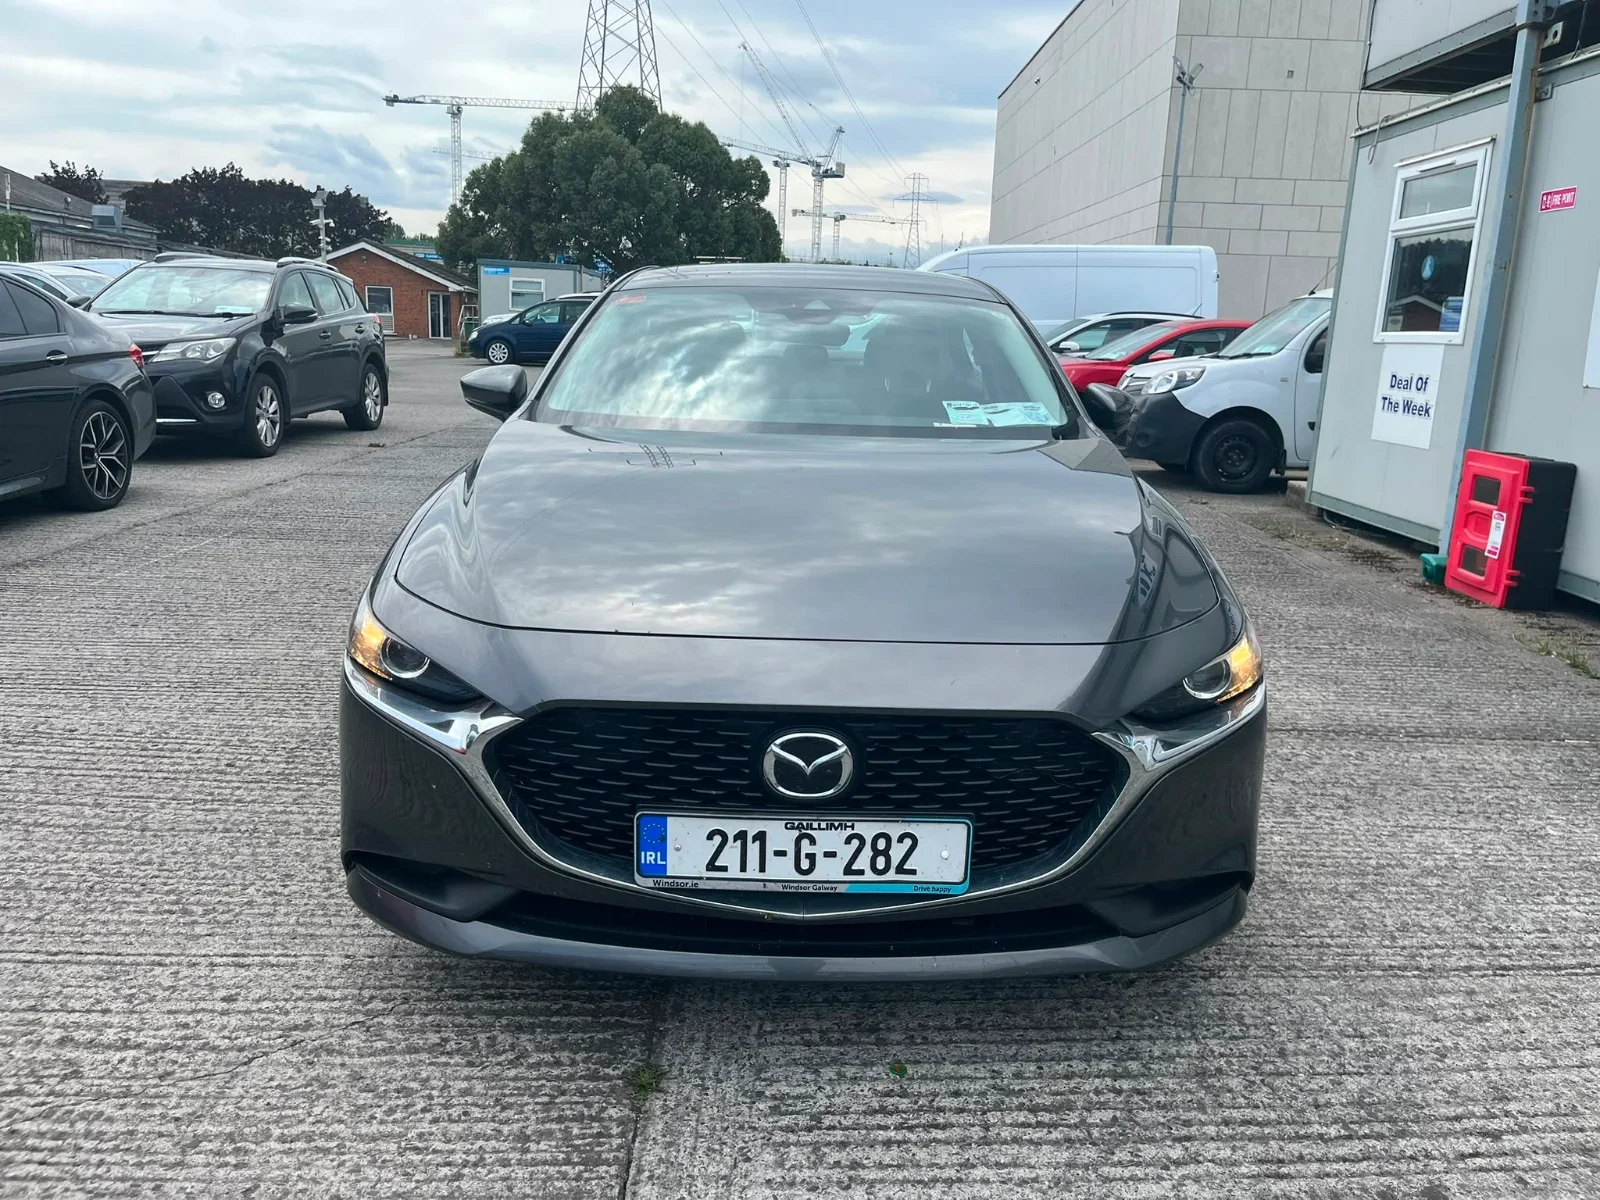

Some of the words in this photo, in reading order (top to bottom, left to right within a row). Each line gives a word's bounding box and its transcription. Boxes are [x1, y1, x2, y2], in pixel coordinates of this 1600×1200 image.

[1552, 194, 1562, 205] FIRE
[1390, 374, 1413, 390] Deal
[1416, 377, 1429, 392] Of
[1382, 396, 1399, 412] The
[1402, 399, 1431, 417] Week
[784, 821, 855, 832] GAILLIMH
[705, 828, 919, 876] 211-G-282
[641, 851, 666, 865] IRL
[653, 879, 699, 888] Windsor.ie
[782, 884, 811, 892] Windsor
[812, 884, 838, 893] Galway
[913, 885, 931, 894] Drive
[931, 886, 952, 895] happy
